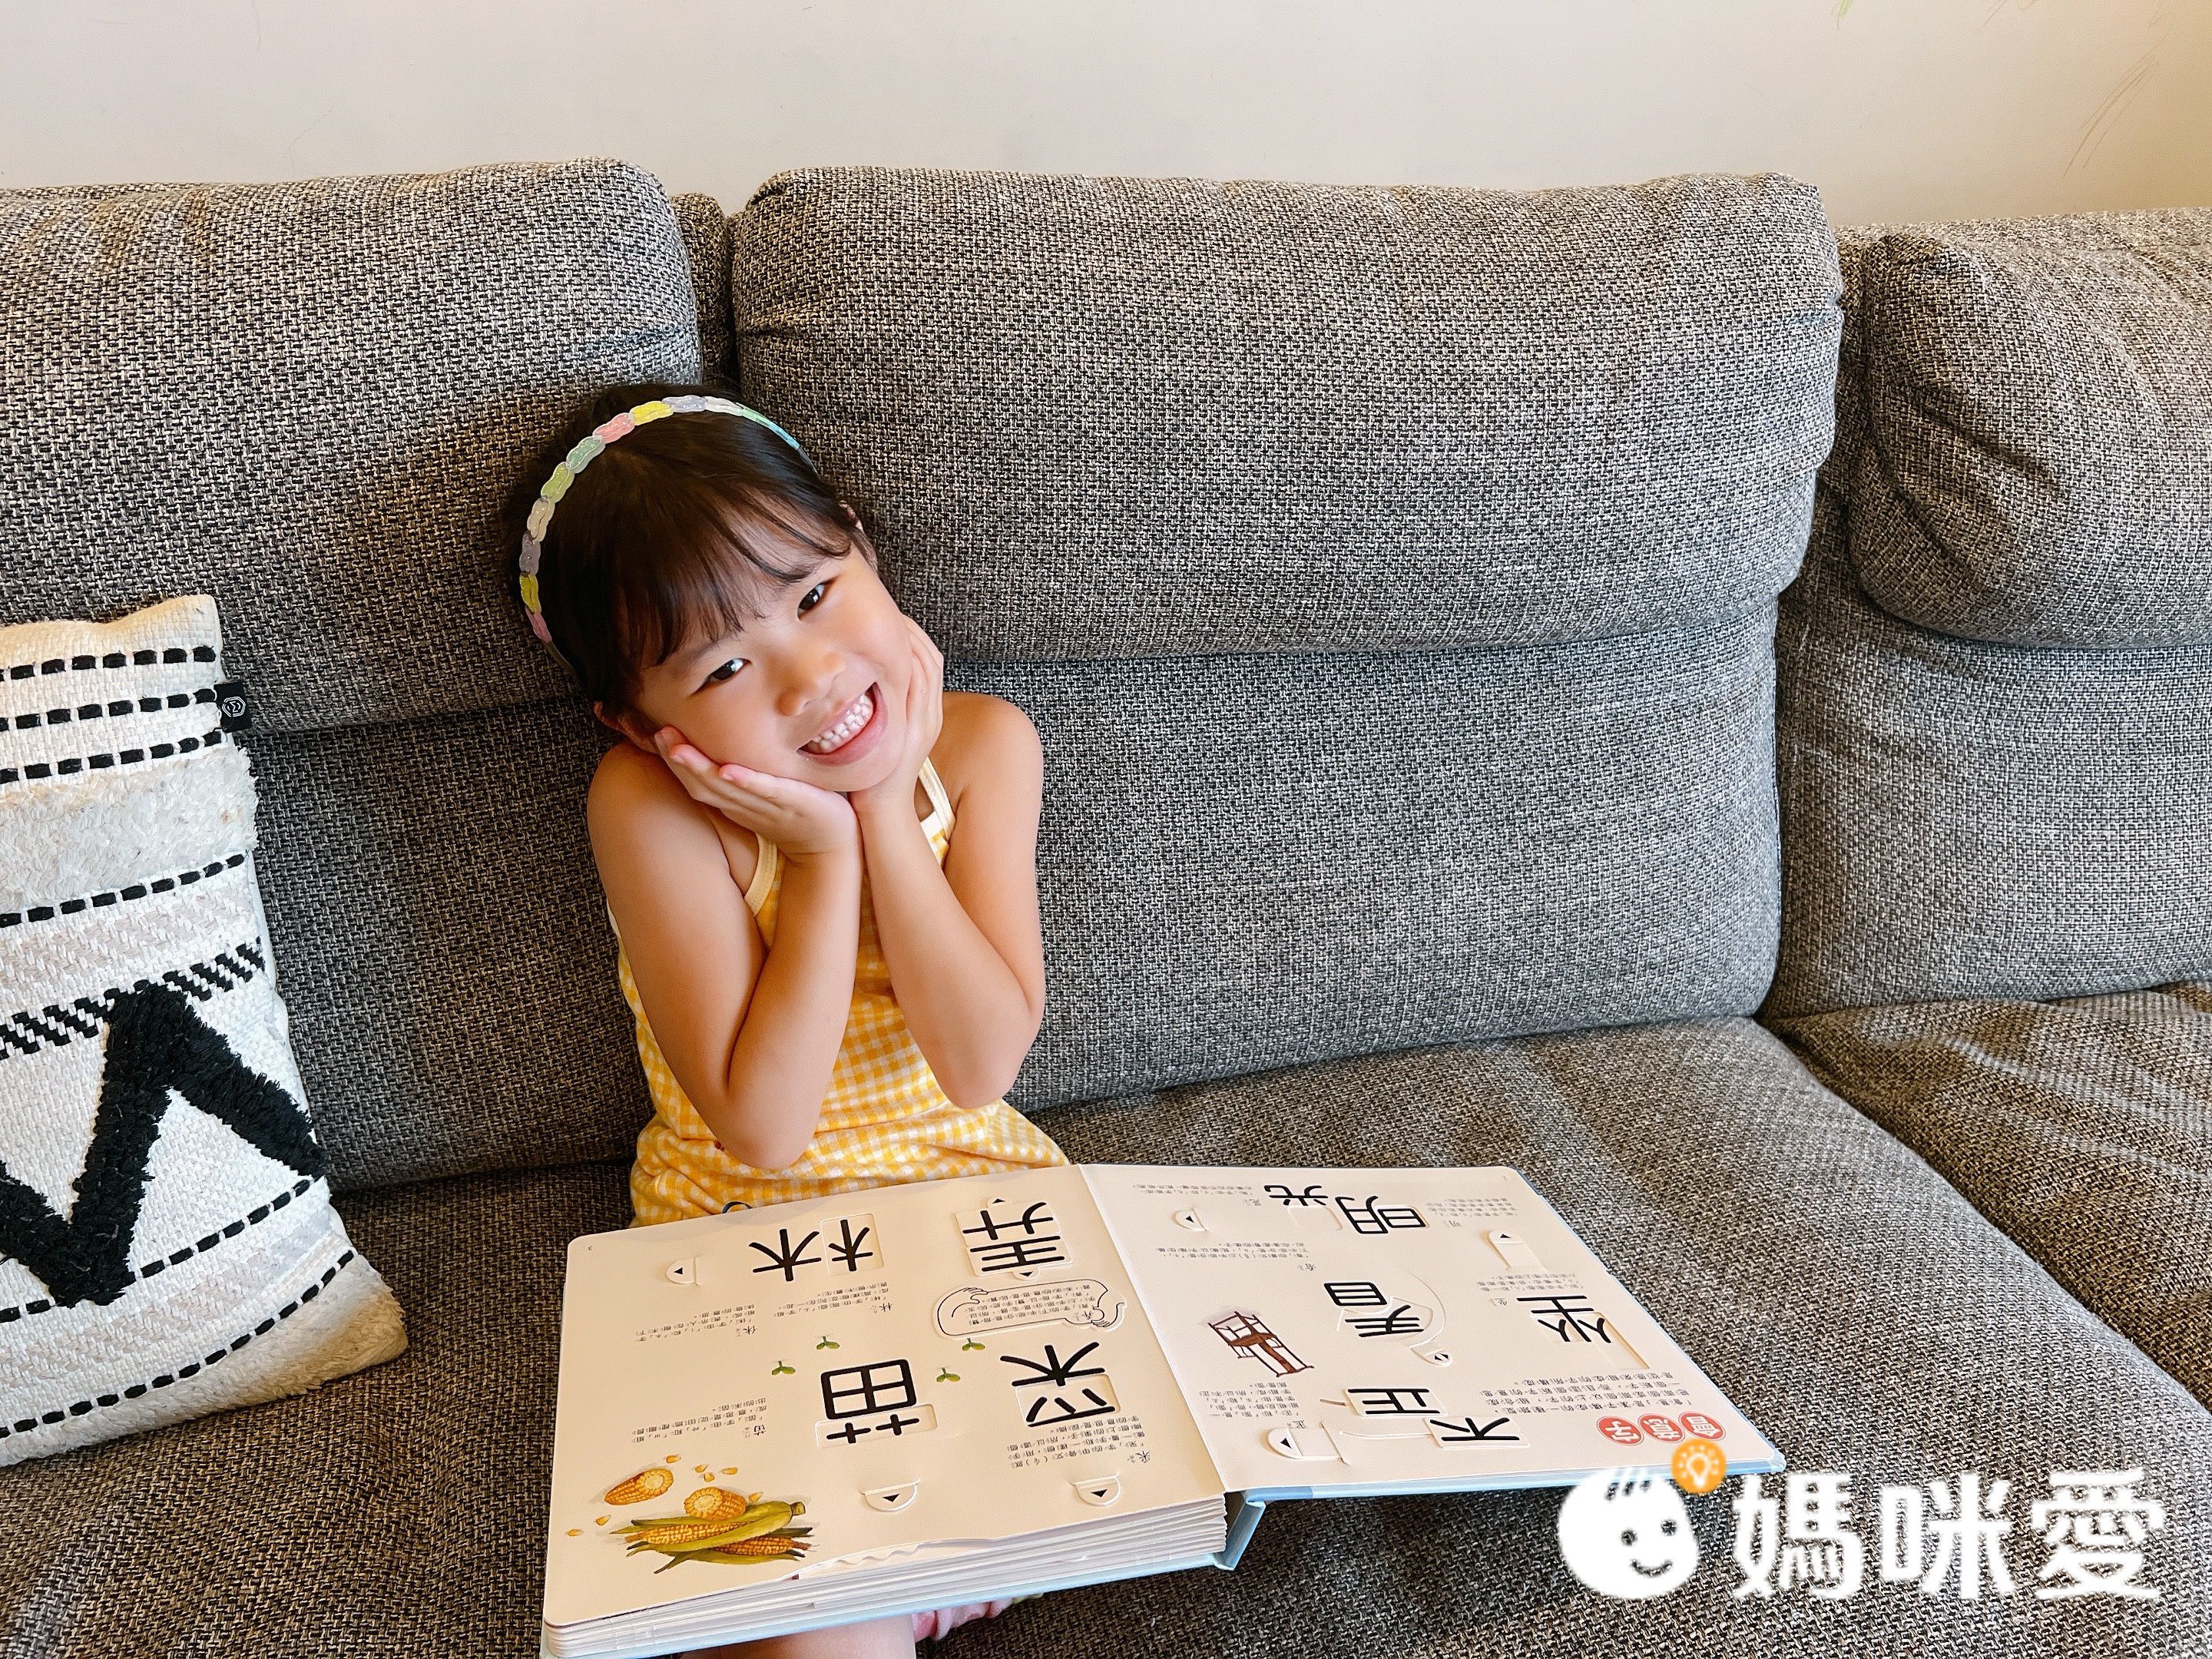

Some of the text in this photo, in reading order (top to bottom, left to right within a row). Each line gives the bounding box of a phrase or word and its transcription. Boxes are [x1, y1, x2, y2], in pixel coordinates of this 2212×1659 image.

[963, 1203, 1065, 1271] 弄
[1335, 1196, 1426, 1233] 明
[749, 1220, 873, 1281] 林
[1324, 1283, 1424, 1337] 看
[1517, 1296, 1611, 1343] 坐
[821, 1359, 919, 1444] 苗
[1000, 1343, 1115, 1427] 采
[1348, 1389, 1440, 1414] 正
[1430, 1418, 1519, 1441] 不
